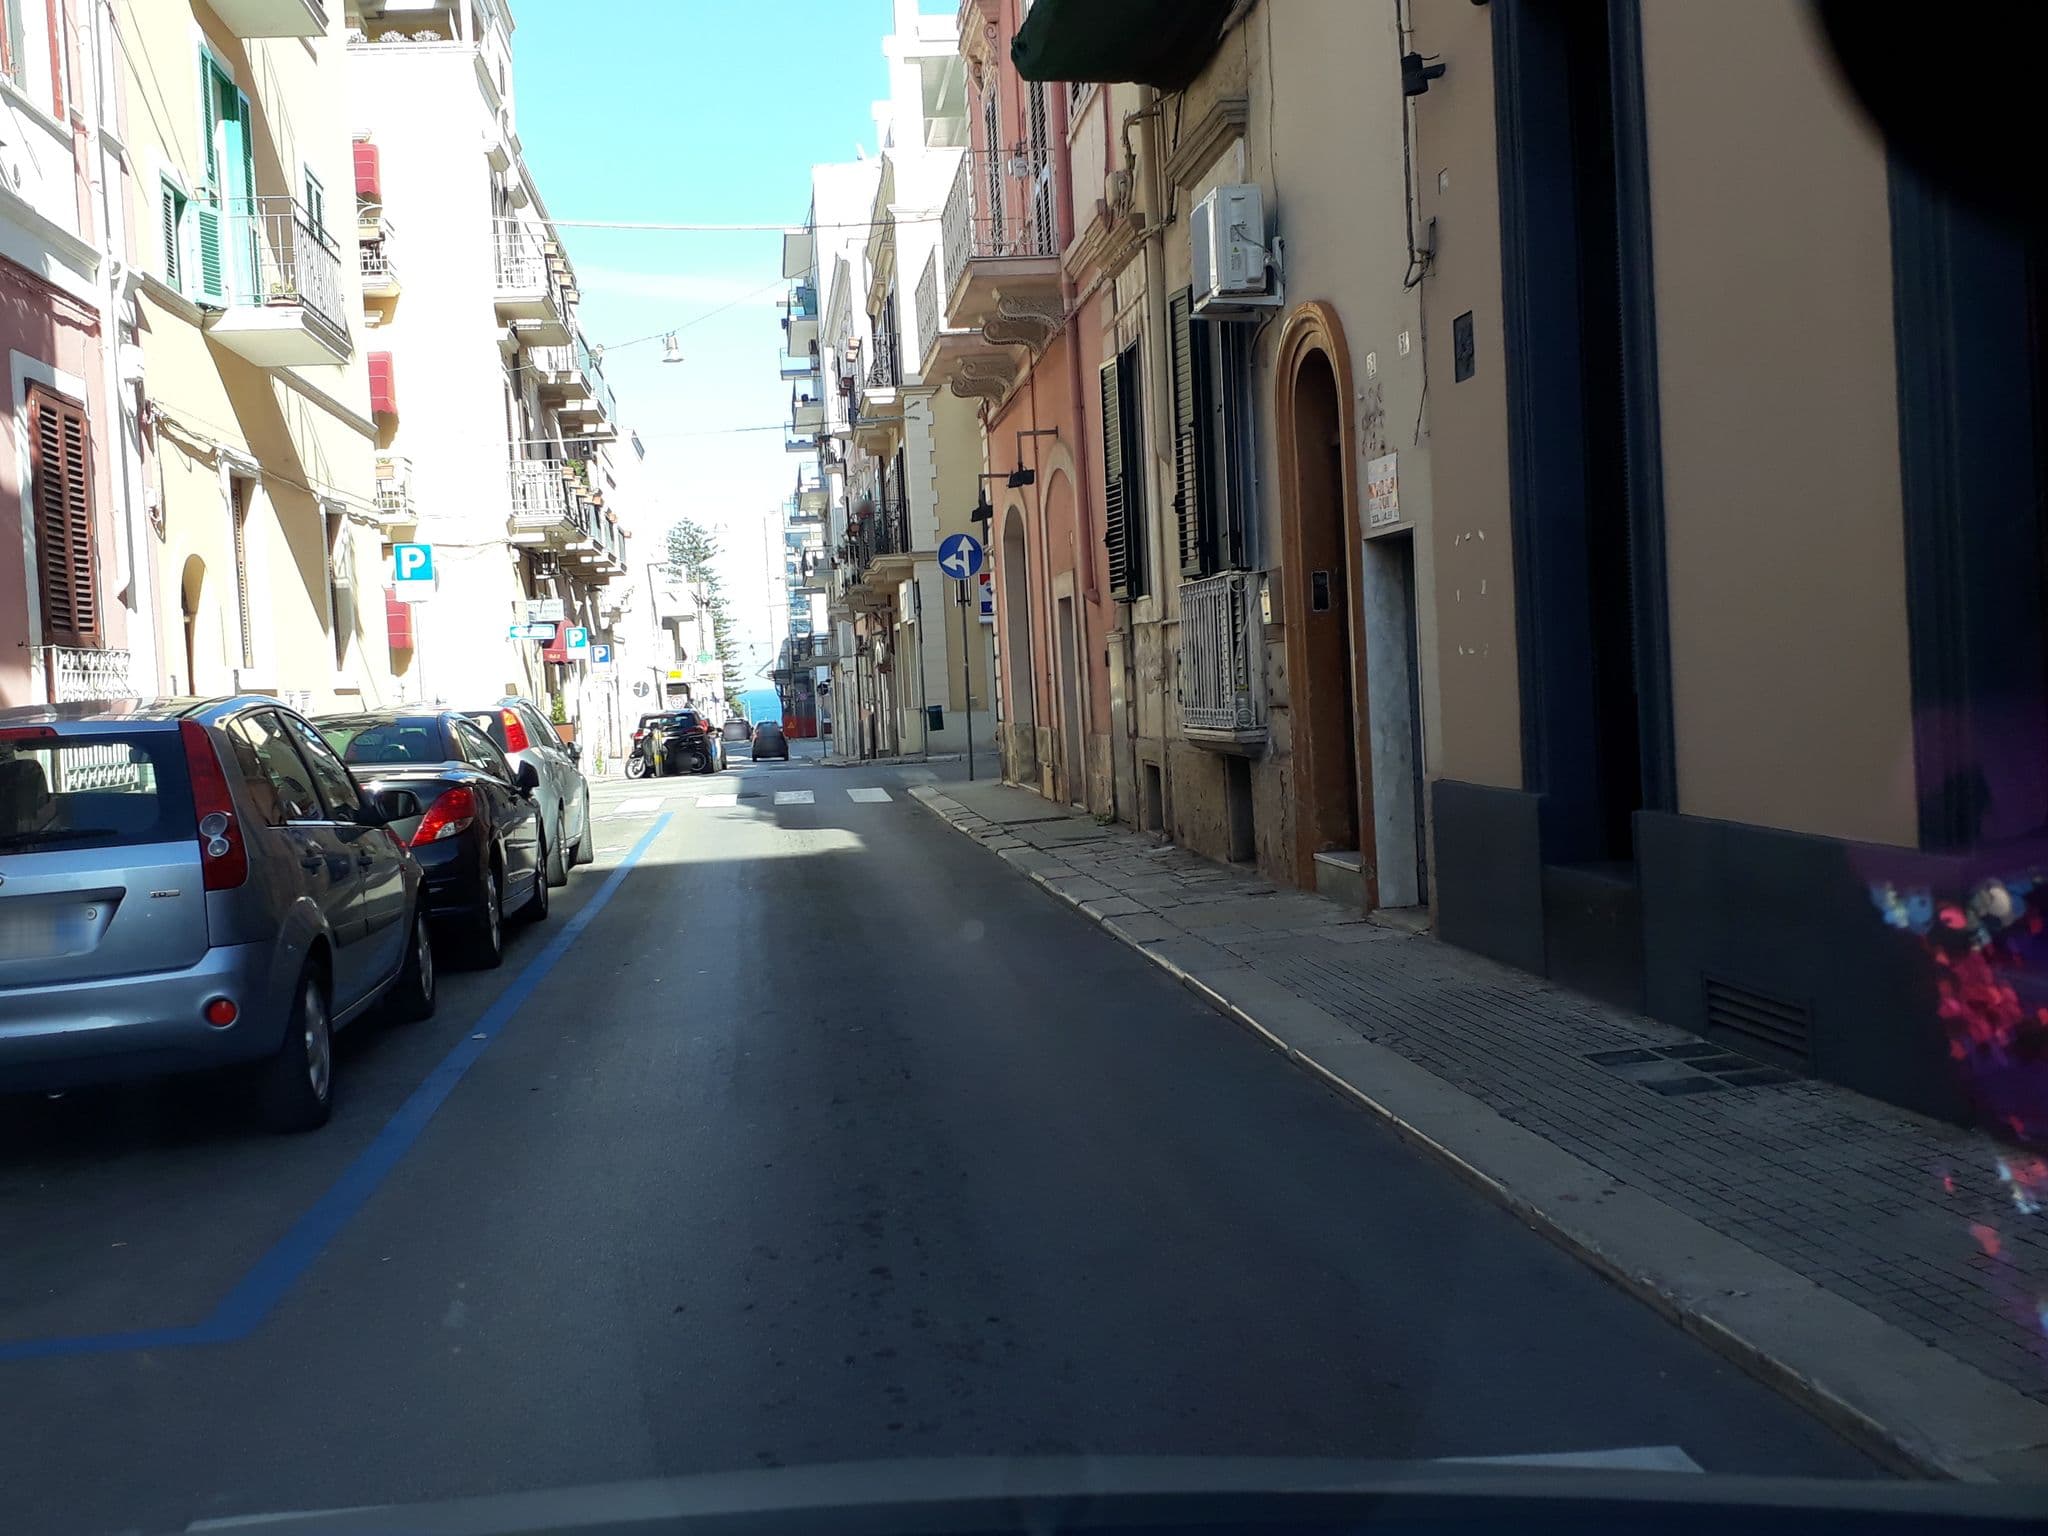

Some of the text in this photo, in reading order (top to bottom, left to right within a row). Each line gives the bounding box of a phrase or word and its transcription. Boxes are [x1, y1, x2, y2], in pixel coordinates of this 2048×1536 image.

[400, 547, 426, 578] P
[570, 630, 583, 647] P
[594, 647, 606, 663] P
